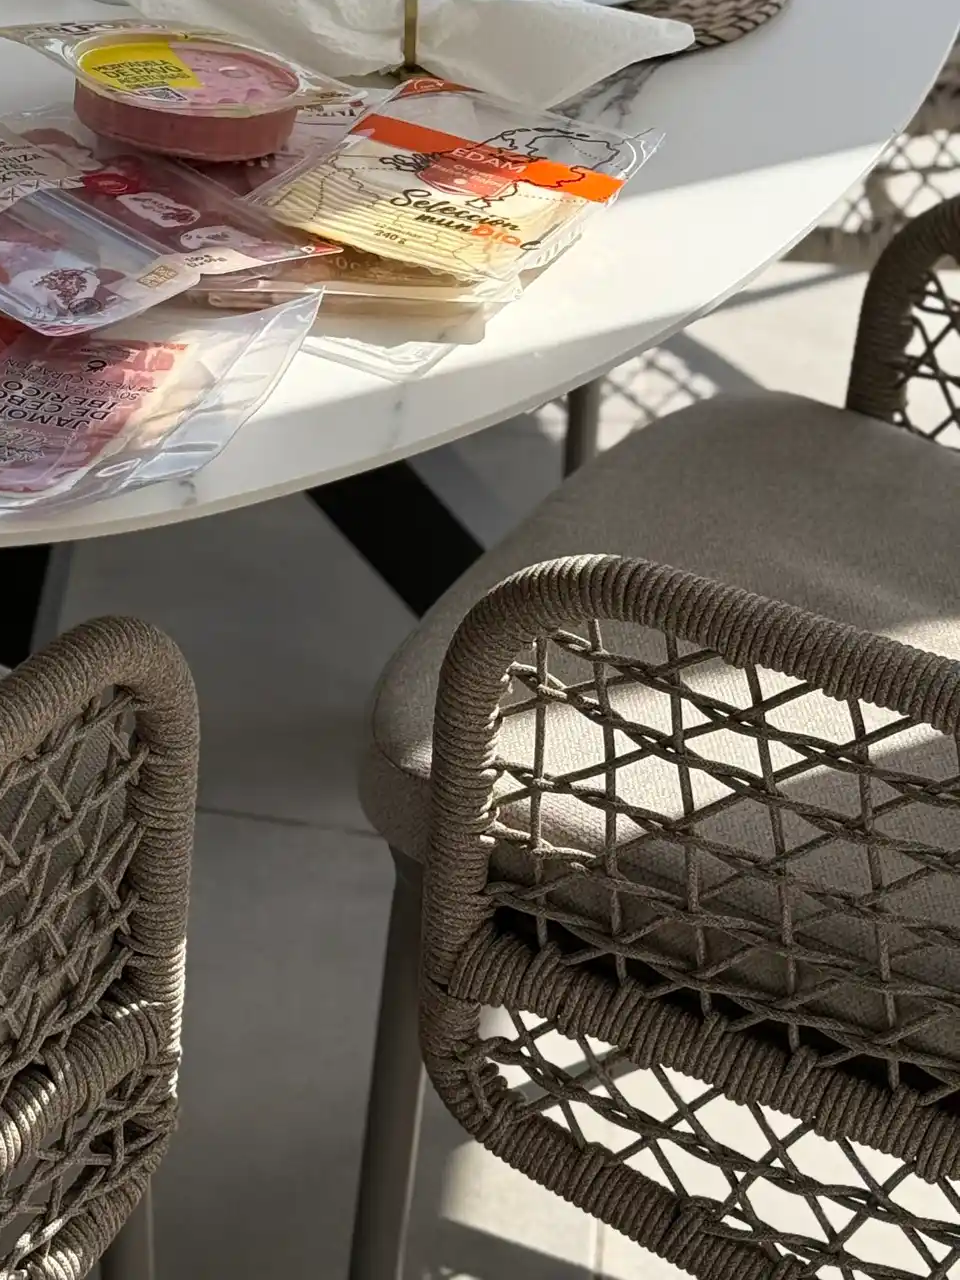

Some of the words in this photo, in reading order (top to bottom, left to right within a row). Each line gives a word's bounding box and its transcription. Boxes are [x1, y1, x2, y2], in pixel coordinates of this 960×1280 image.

[451, 148, 527, 173] EDAM
[390, 188, 521, 232] Selección
[373, 230, 399, 241] 240
[70, 407, 112, 422] DE
